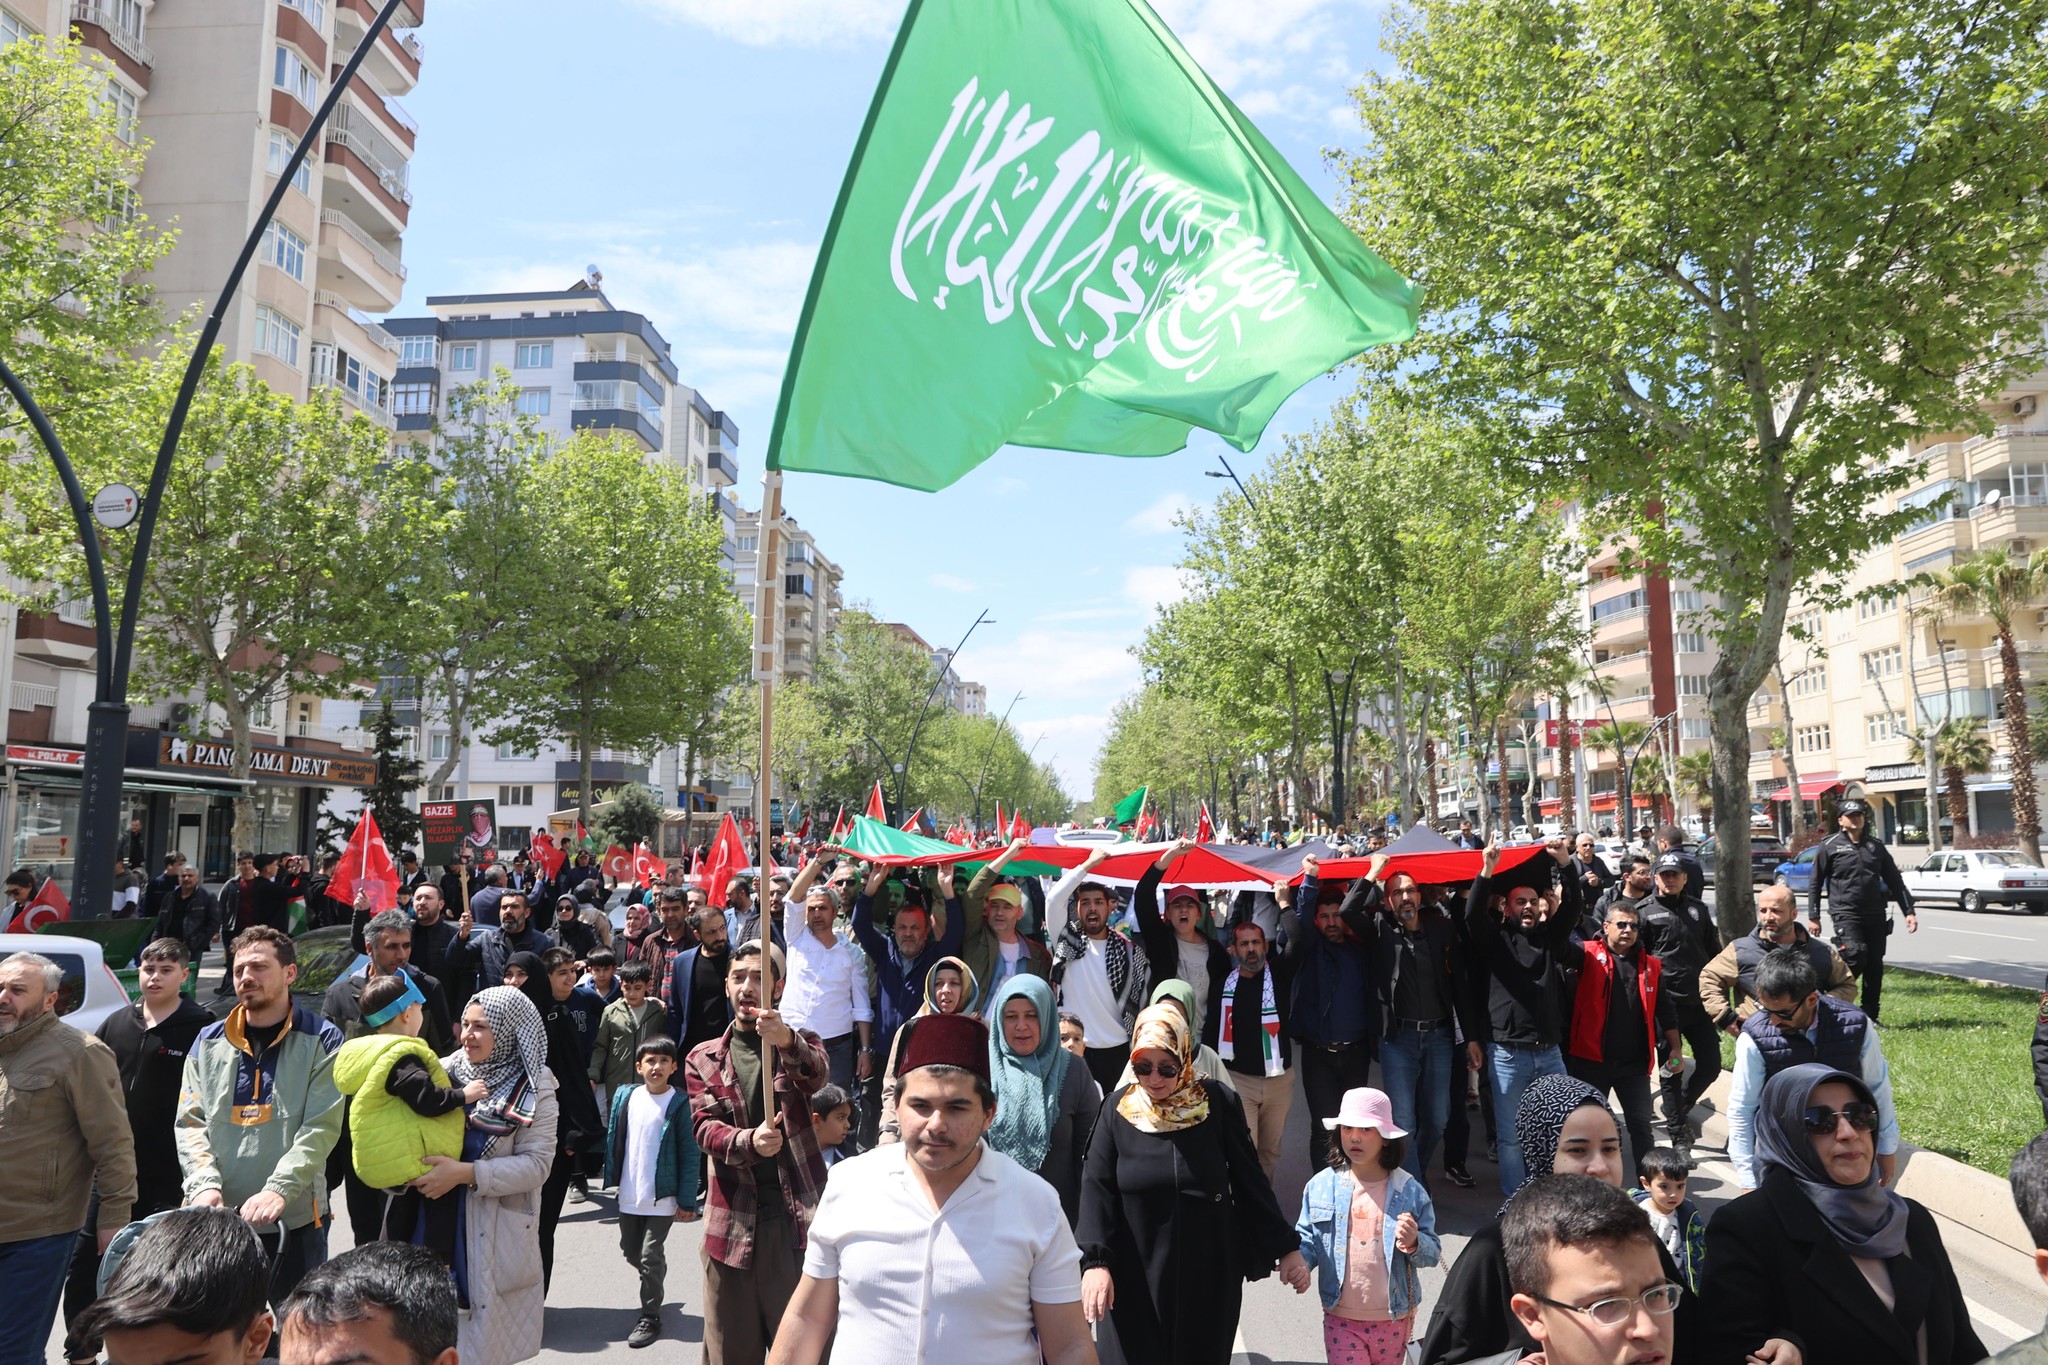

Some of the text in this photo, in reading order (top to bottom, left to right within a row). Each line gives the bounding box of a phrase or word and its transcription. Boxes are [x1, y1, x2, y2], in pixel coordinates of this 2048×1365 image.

[37, 751, 69, 762] POLAT
[193, 744, 284, 772] PANAMA
[290, 756, 330, 776] DENT
[424, 805, 453, 816] GAZZE
[426, 826, 464, 834] MEZARLIK
